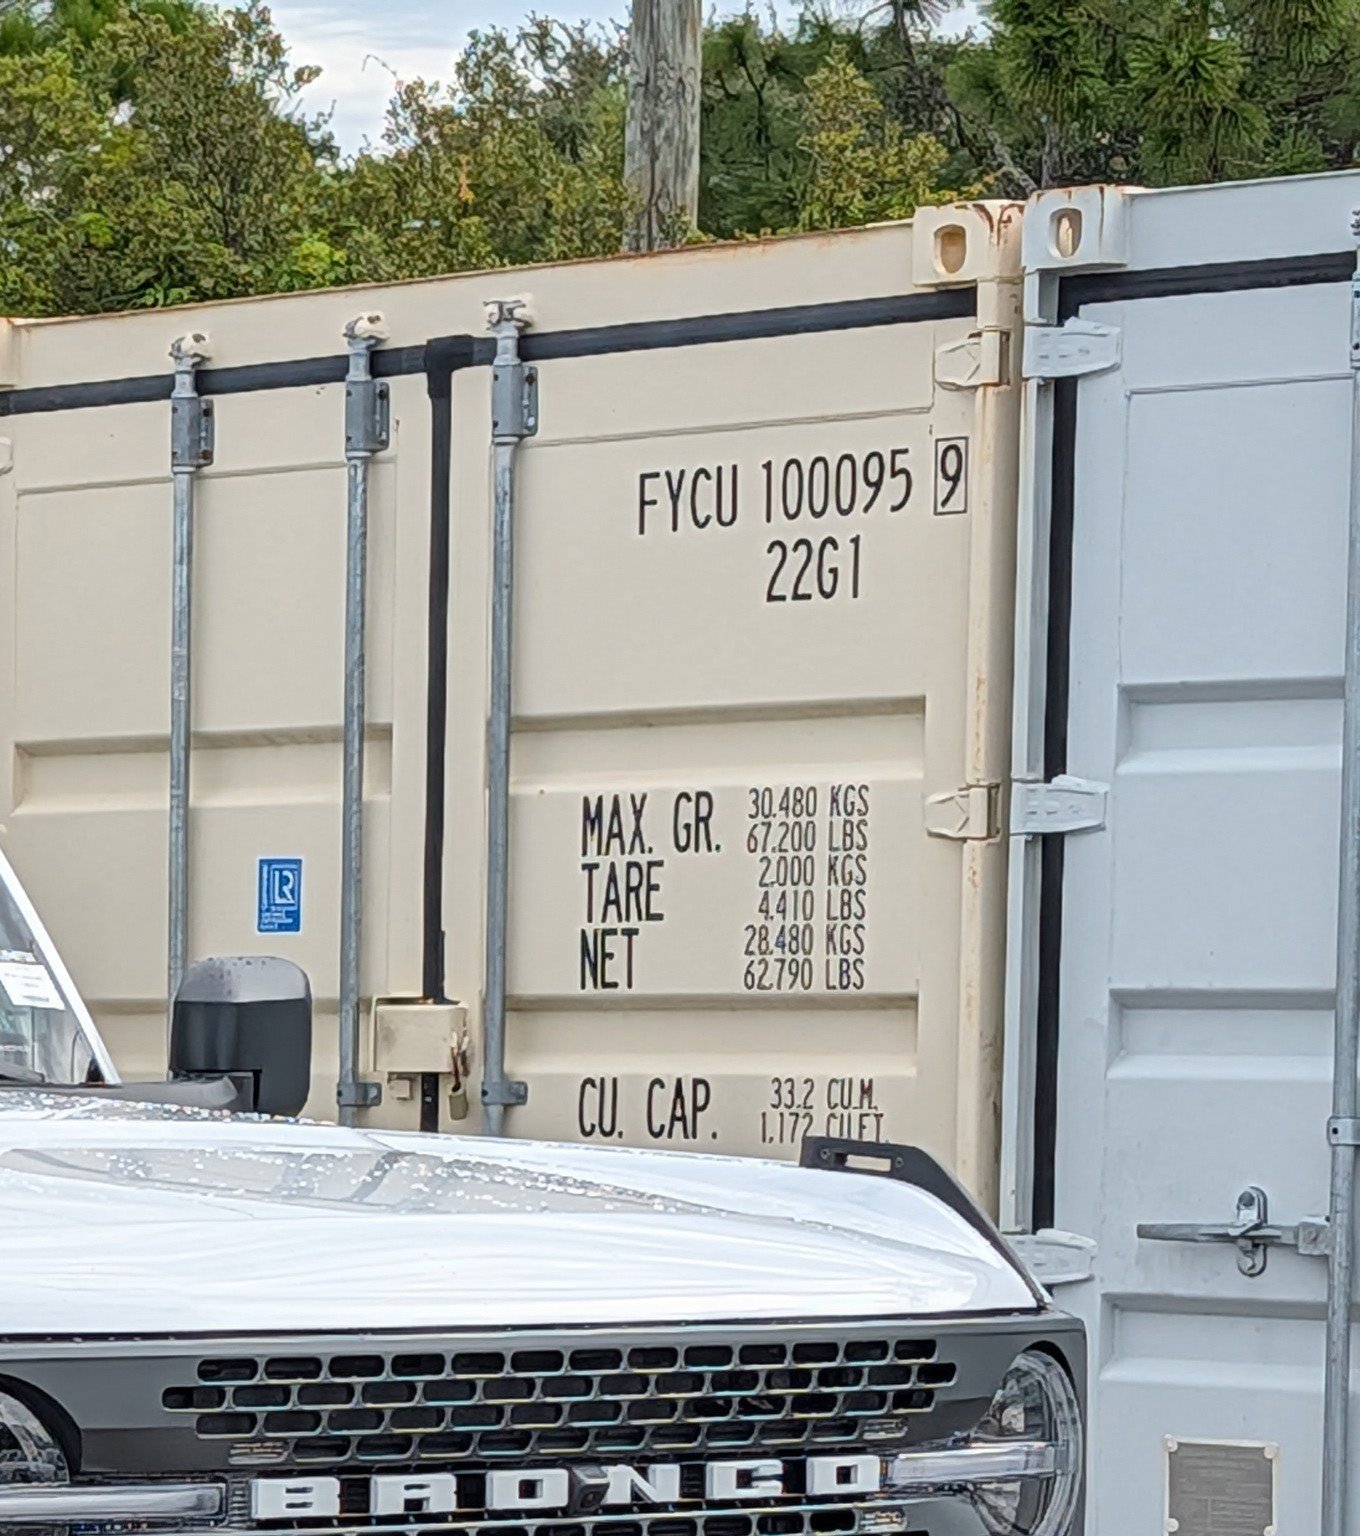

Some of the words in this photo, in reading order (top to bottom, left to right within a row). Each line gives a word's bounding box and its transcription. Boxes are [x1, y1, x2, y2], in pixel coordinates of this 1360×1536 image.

[637, 464, 739, 536] FYCU
[761, 447, 913, 525] 100095
[939, 443, 964, 509] 9
[766, 533, 860, 603] 22G1
[581, 792, 654, 857] MAX.
[672, 790, 722, 854] GR.
[747, 786, 818, 820] 30.480
[829, 784, 870, 817] KGS
[746, 820, 817, 854] 67.200
[827, 818, 868, 852] LBS
[581, 859, 664, 928] TARE
[758, 855, 815, 888] 2.000
[827, 853, 867, 887] KGS
[757, 889, 815, 922] 4.410
[826, 888, 866, 921] LBS
[580, 927, 640, 990] NET
[743, 923, 814, 957] 28.480
[825, 923, 866, 956] KGS
[825, 957, 865, 991] LBS
[578, 1076, 623, 1140] CU.
[646, 1077, 718, 1141] CAP.
[769, 1077, 815, 1111] 33.2
[250, 1453, 888, 1521] BRONCO
